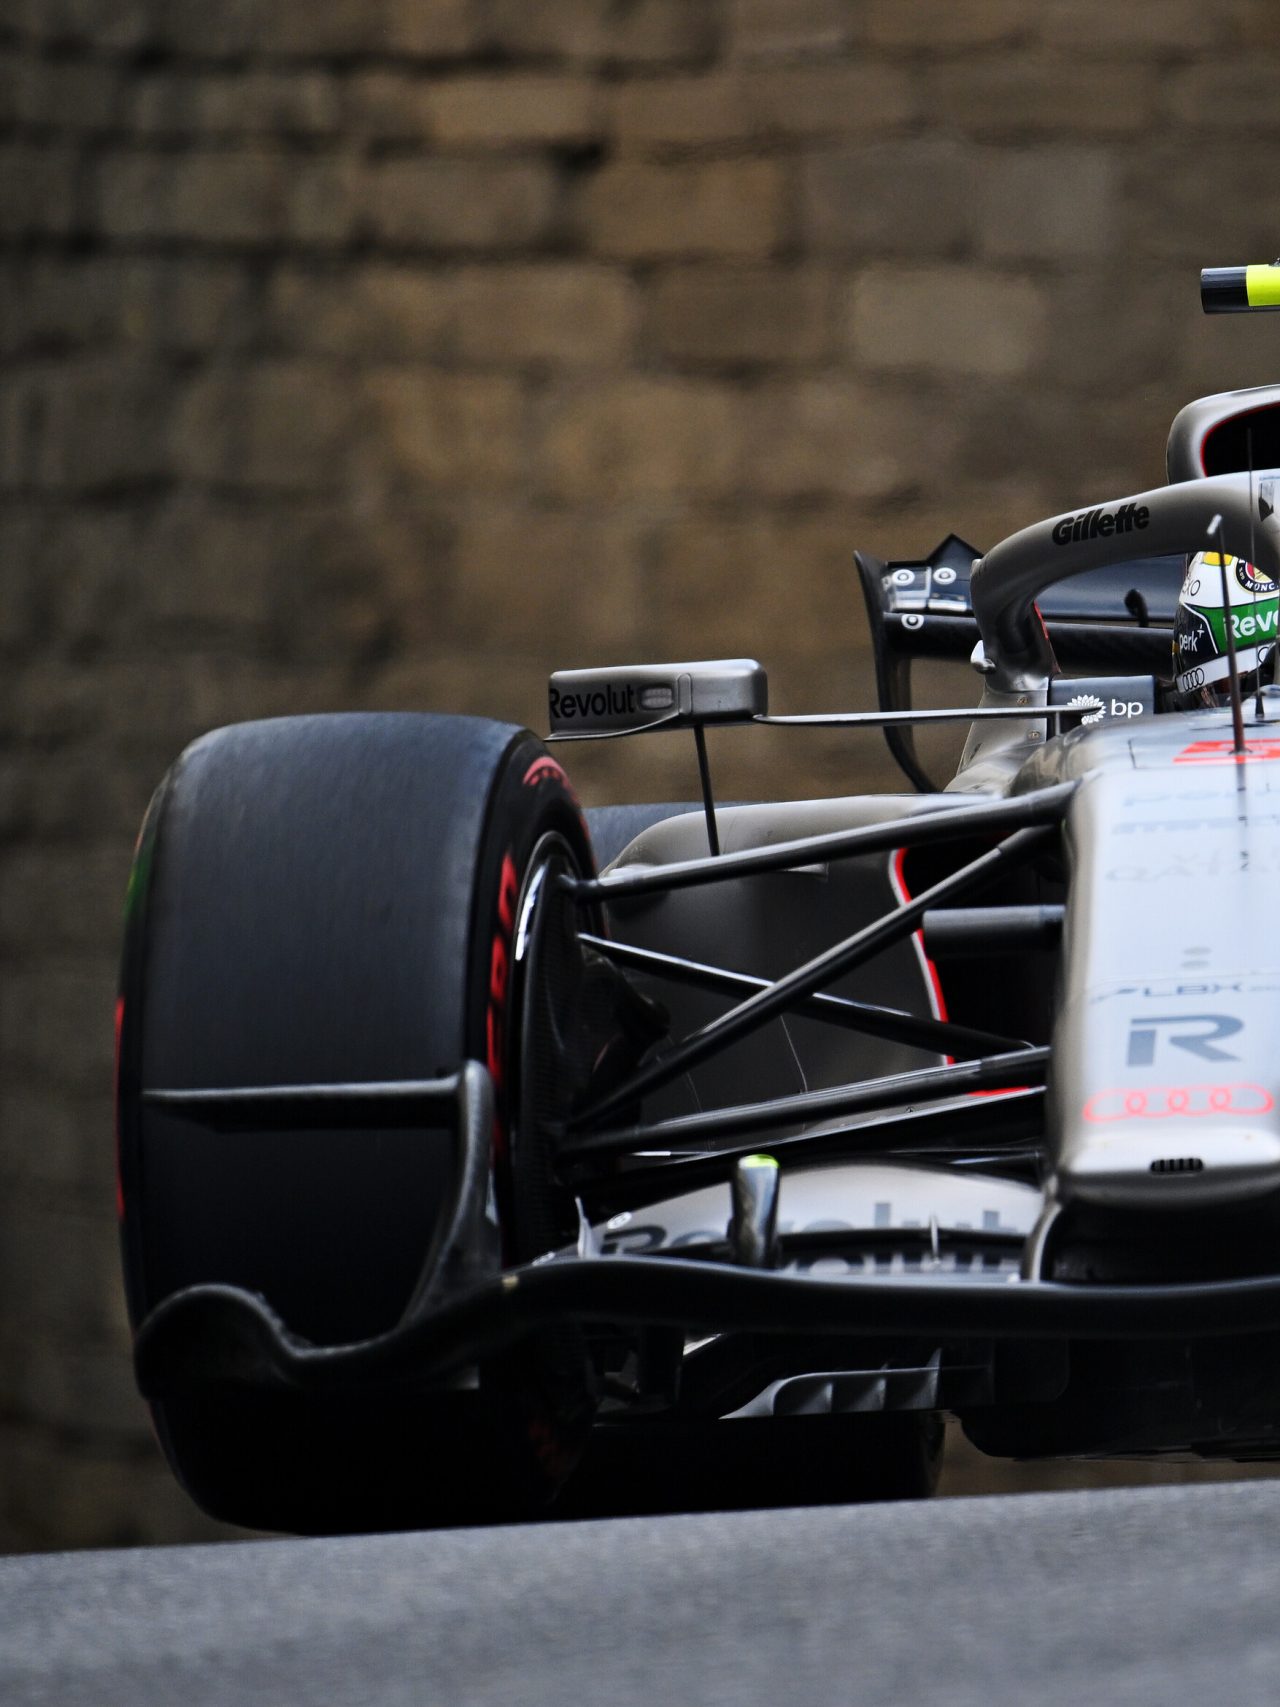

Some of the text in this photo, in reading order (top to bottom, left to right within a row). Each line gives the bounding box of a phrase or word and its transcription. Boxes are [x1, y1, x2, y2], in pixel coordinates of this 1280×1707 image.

[1052, 502, 1151, 546] Gillette
[549, 684, 635, 719] Revolut
[1110, 698, 1144, 719] bp
